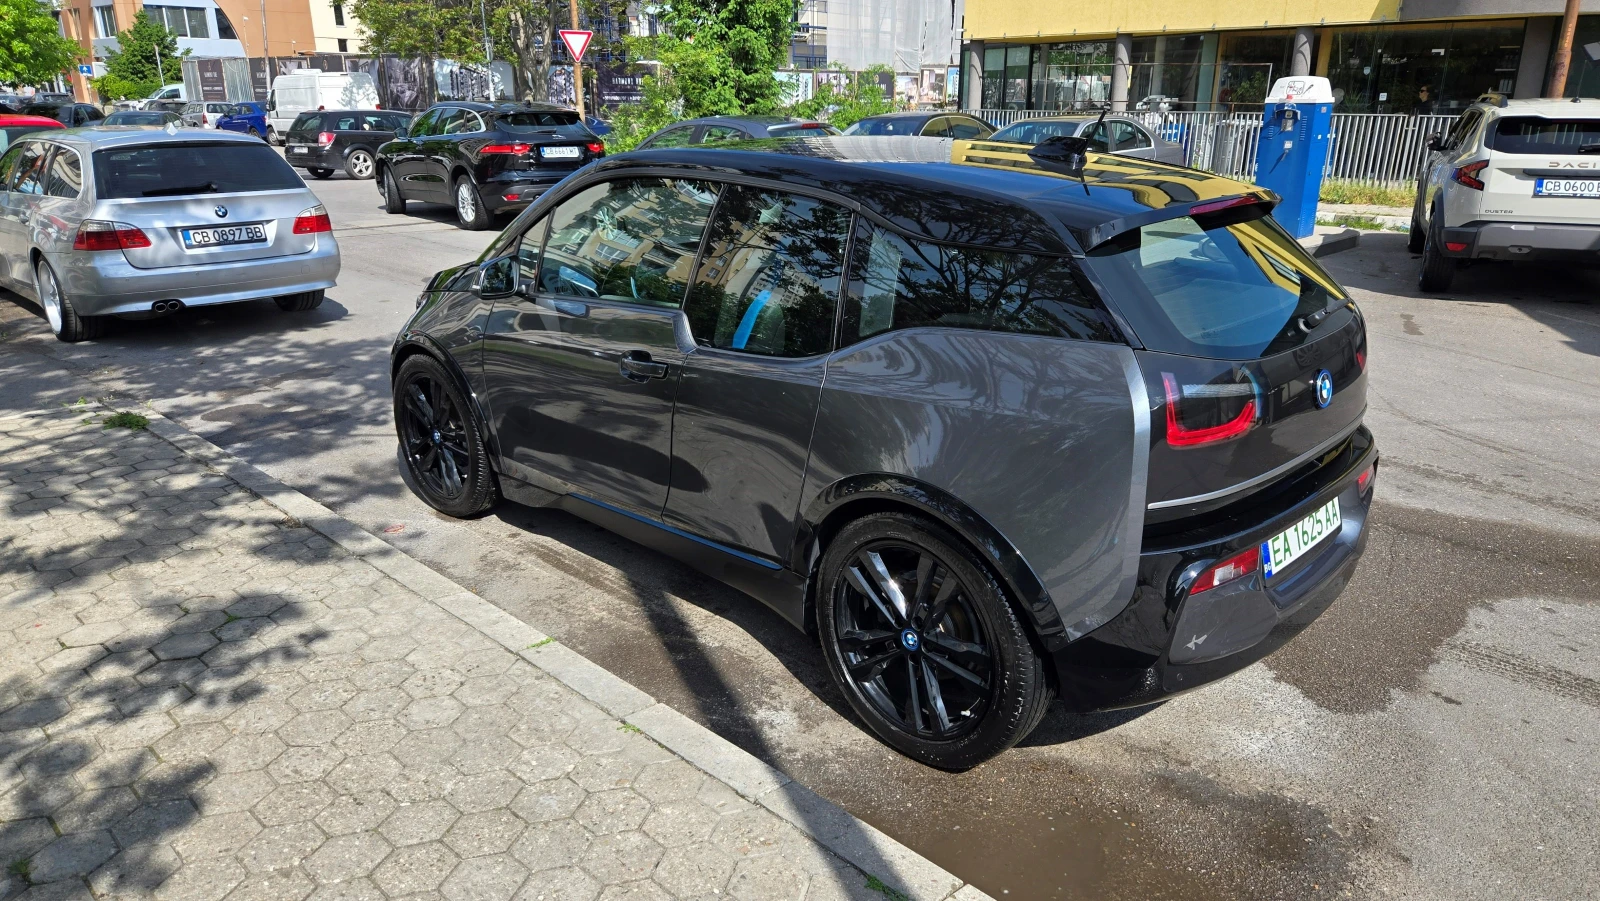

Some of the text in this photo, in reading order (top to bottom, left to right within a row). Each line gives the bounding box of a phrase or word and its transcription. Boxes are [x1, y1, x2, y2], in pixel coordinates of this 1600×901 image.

[1548, 161, 1597, 169] DACI
[1545, 181, 1561, 192] CB
[1563, 181, 1595, 192] 0600
[192, 226, 263, 244] CB 0897 BB
[1271, 499, 1339, 568] EA 1625 AA
[1264, 562, 1272, 574] BG
